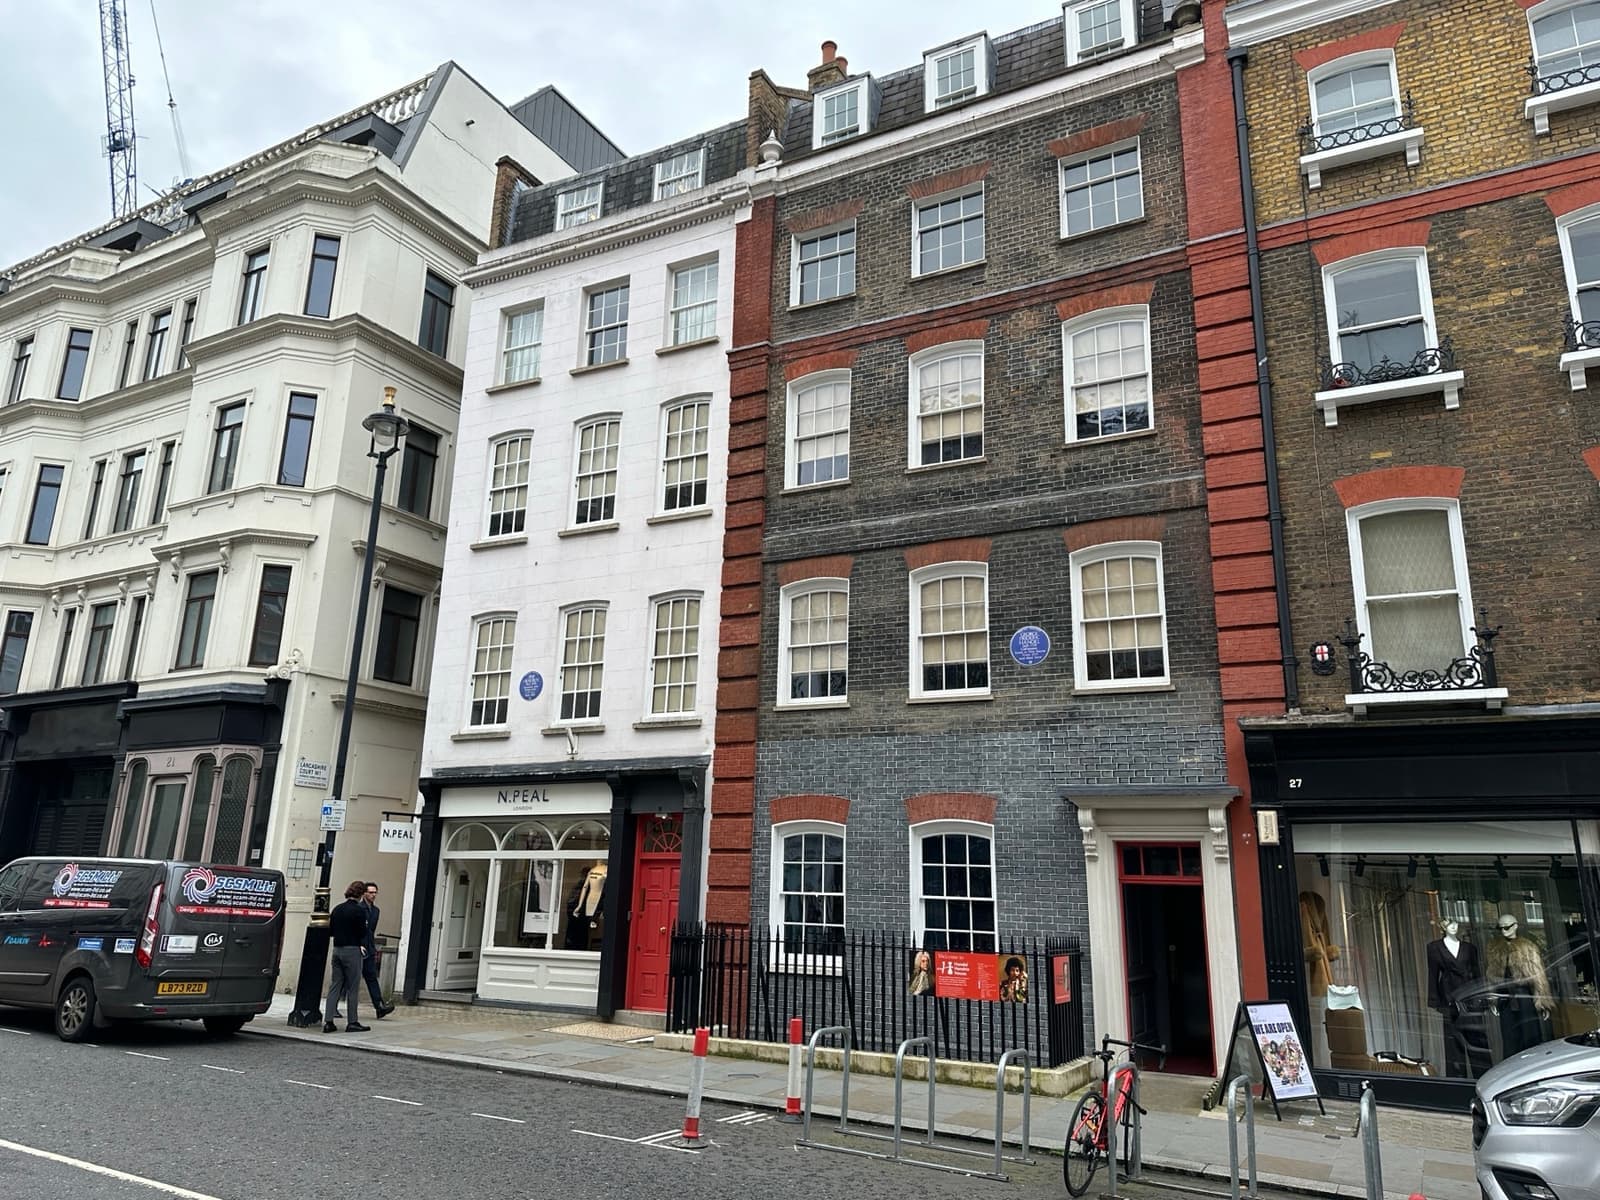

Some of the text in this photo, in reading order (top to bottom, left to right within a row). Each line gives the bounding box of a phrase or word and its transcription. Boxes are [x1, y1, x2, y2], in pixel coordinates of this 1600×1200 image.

[299, 767, 314, 775] COURT
[300, 762, 327, 772] LANCASHIRE
[1289, 779, 1302, 788] 27
[498, 789, 549, 803] N.PEAL
[382, 829, 414, 839] N.PEAL
[204, 933, 223, 947] CHAS
[161, 983, 185, 993] LB73
[1254, 1022, 1294, 1035] WE ARE OPEN
